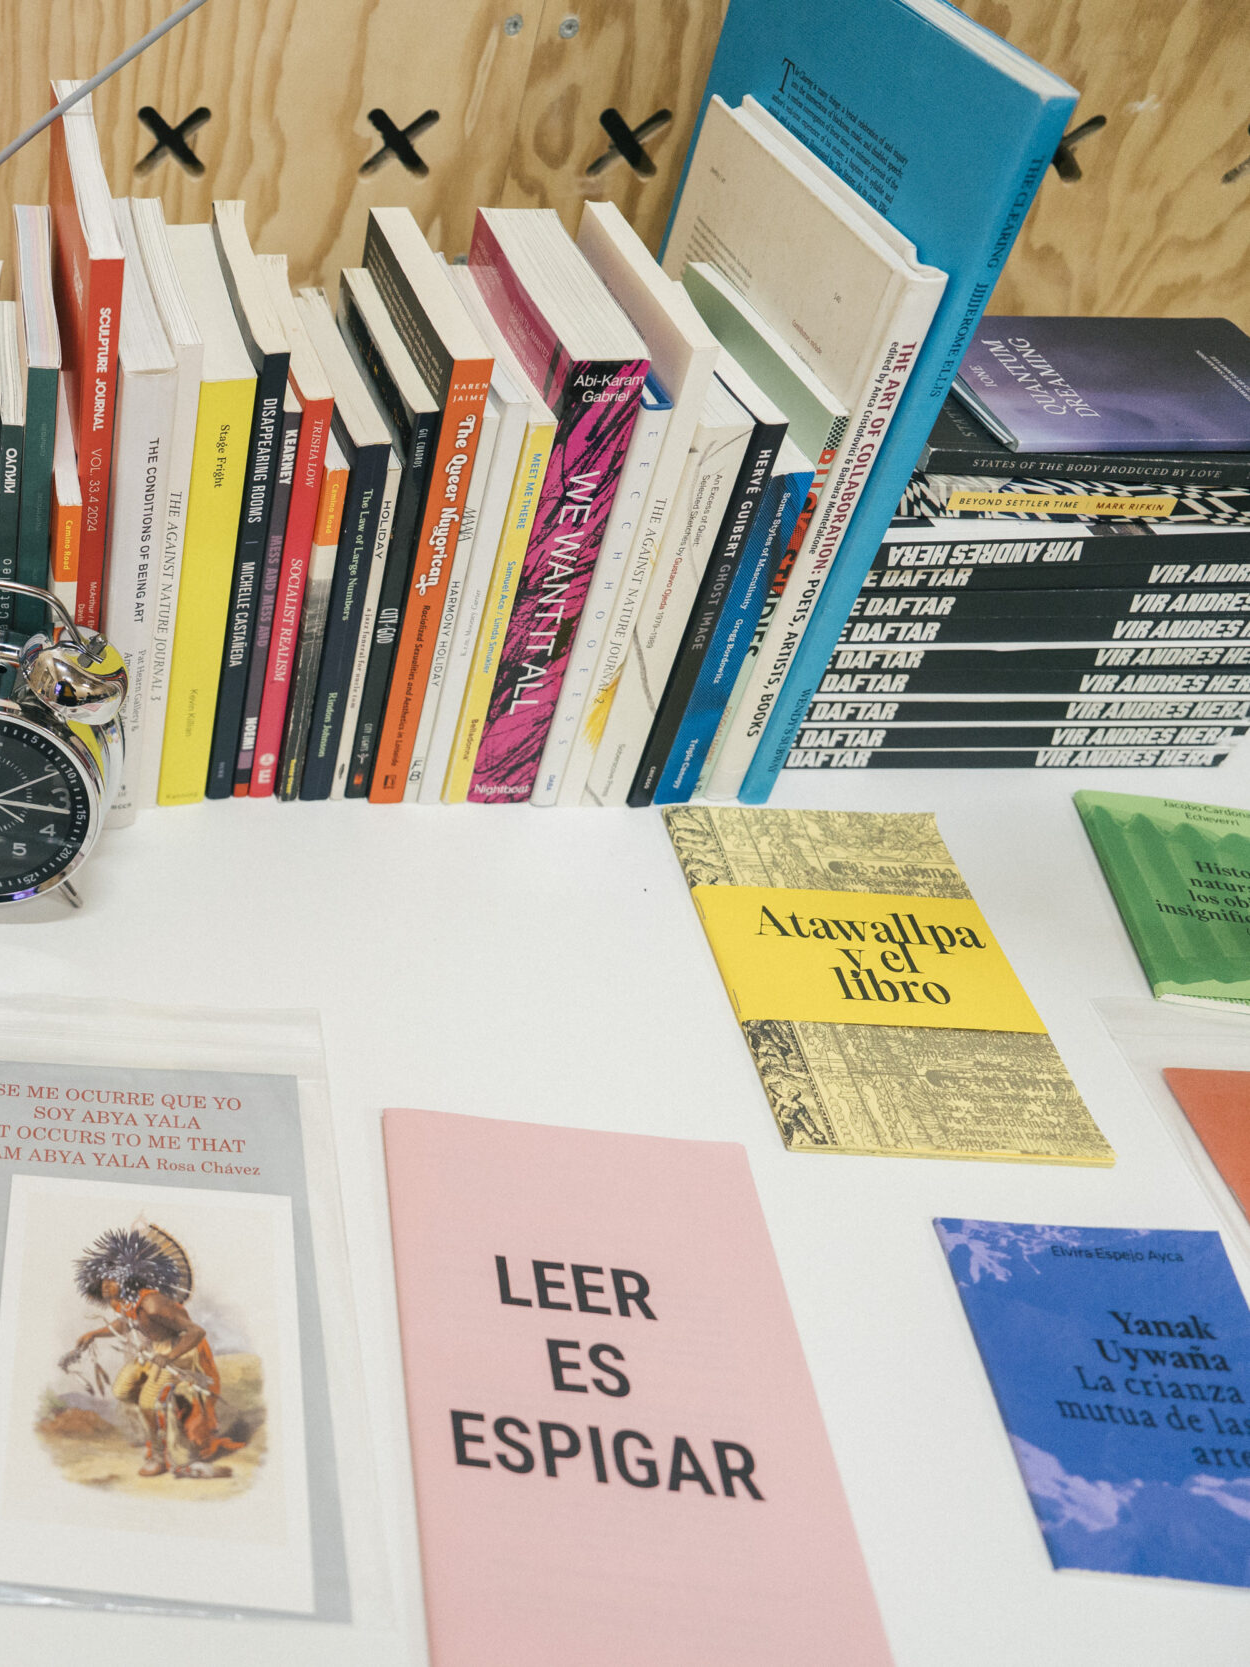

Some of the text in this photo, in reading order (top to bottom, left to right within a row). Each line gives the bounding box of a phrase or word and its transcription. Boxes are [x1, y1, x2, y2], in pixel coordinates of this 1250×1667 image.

[573, 374, 645, 387] Abi-Karam
[980, 339, 1067, 416] QUANTUM
[1007, 337, 1101, 418] DREAMING
[452, 394, 485, 403] JAIME
[582, 391, 630, 403] Gabriel
[87, 307, 111, 532] SCULPTURE JOURNAL VOL. 33.4 2024
[4, 448, 18, 494] KIKUYO
[213, 424, 230, 489] Stage Fright
[279, 428, 299, 485] KEARNEY
[972, 459, 1222, 478] STATES OF THE BODY PRODUCED BY LOVE
[429, 414, 477, 588] The Queer Nuyorican
[959, 498, 1002, 506] BEYOND
[1006, 499, 1050, 507] SETTLER
[1095, 502, 1125, 510] MARK
[1129, 503, 1164, 511] RIFKIN
[229, 397, 278, 668] DISAPPEARING ROOMS MICHELLE CASTAÑEDA
[747, 341, 917, 738] THE ART OF COLLABORATION: POETS, ARTISTS, BOOKS
[274, 419, 324, 682] TRISHA LOW SOCIALIST REALISM
[691, 449, 772, 651] HERVÉ GUIBERT GHOST IMAGE
[887, 541, 1084, 567] VIR ANDRES HERA
[509, 471, 601, 716] WE WANT IT ALL
[863, 597, 956, 616] DAFTAR
[850, 622, 941, 642] DAFTAR
[820, 674, 910, 692] DAFTAR
[811, 702, 899, 721] DAFTAR
[1051, 728, 1234, 745] VIR ANDRES HERA
[1035, 750, 1214, 767] VIR ANDRES HERA
[474, 783, 530, 794] Nightboat
[12, 843, 26, 856] 5
[755, 905, 986, 954] Atawallpa
[837, 942, 924, 977] y el
[830, 966, 951, 1005] libro
[26, 1085, 59, 1099] ME
[66, 1089, 155, 1106] OCURRE
[161, 1094, 207, 1110] QUE
[212, 1097, 242, 1110] YO
[34, 1106, 202, 1130] SOY ABYA YALA
[17, 1126, 106, 1145] OCCURS
[112, 1133, 141, 1147] TO
[148, 1135, 181, 1149] ME
[187, 1137, 246, 1152] THAT
[28, 1148, 86, 1164] ABYA
[92, 1152, 150, 1168] YALA
[156, 1158, 195, 1172] Rosa
[201, 1161, 261, 1176] Chávez
[1051, 1246, 1184, 1263] Elvira Espejo Ayca
[495, 1254, 658, 1321] LEER
[1108, 1311, 1217, 1340] Yanak
[546, 1338, 631, 1398] ES
[1094, 1339, 1232, 1372] Uywaña
[1074, 1365, 1245, 1404] La crianza
[1056, 1400, 1158, 1427] mutua
[1166, 1405, 1204, 1432] de
[450, 1409, 766, 1502] ESPIGAR
